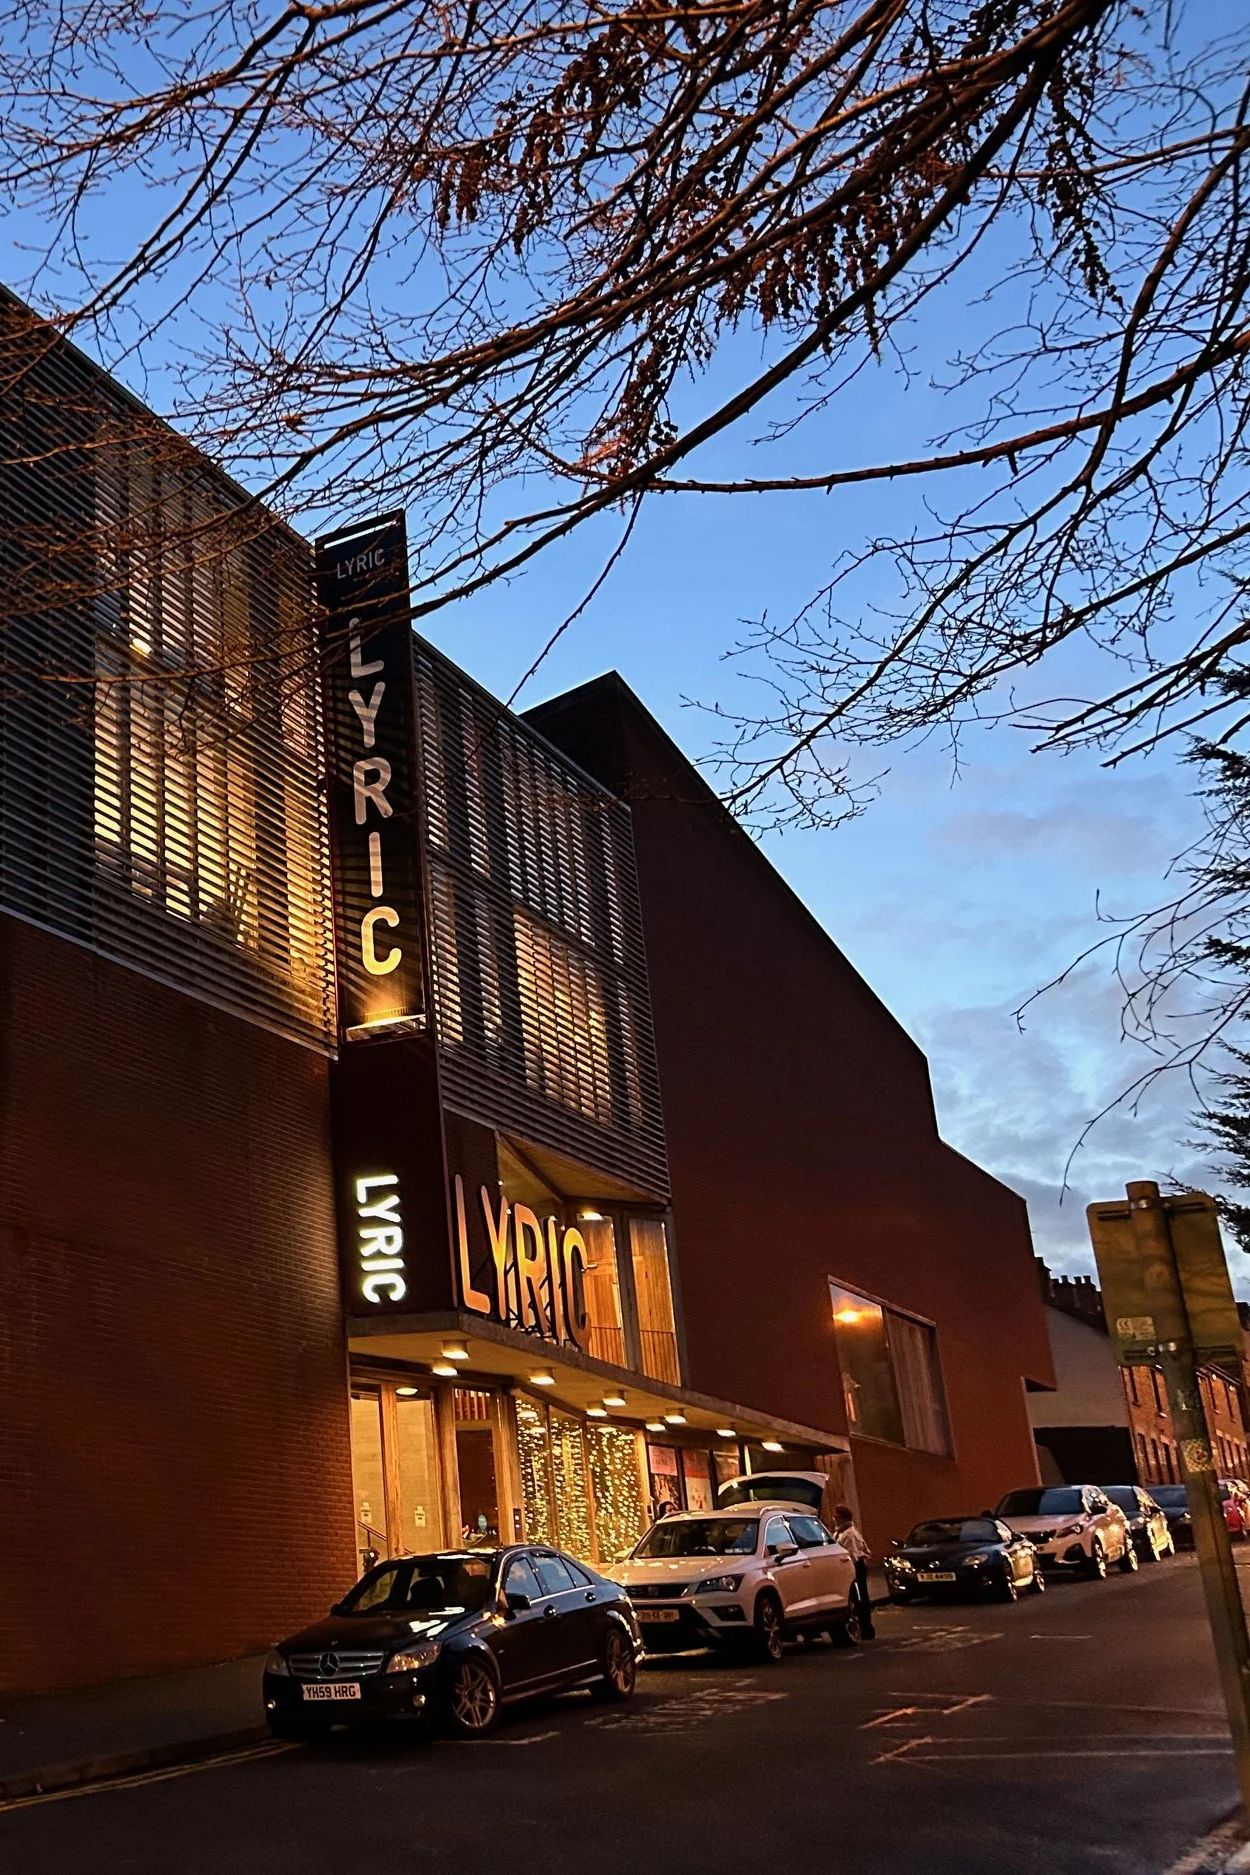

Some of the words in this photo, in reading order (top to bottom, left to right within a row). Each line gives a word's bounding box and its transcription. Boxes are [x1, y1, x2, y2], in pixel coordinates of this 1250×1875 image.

[337, 548, 385, 579] LYRIC
[348, 617, 402, 975] LYRIC
[356, 1173, 407, 1305] LYRIC
[455, 1173, 592, 1350] LYRIC
[306, 1686, 331, 1698] YH59
[334, 1685, 356, 1698] HRG
